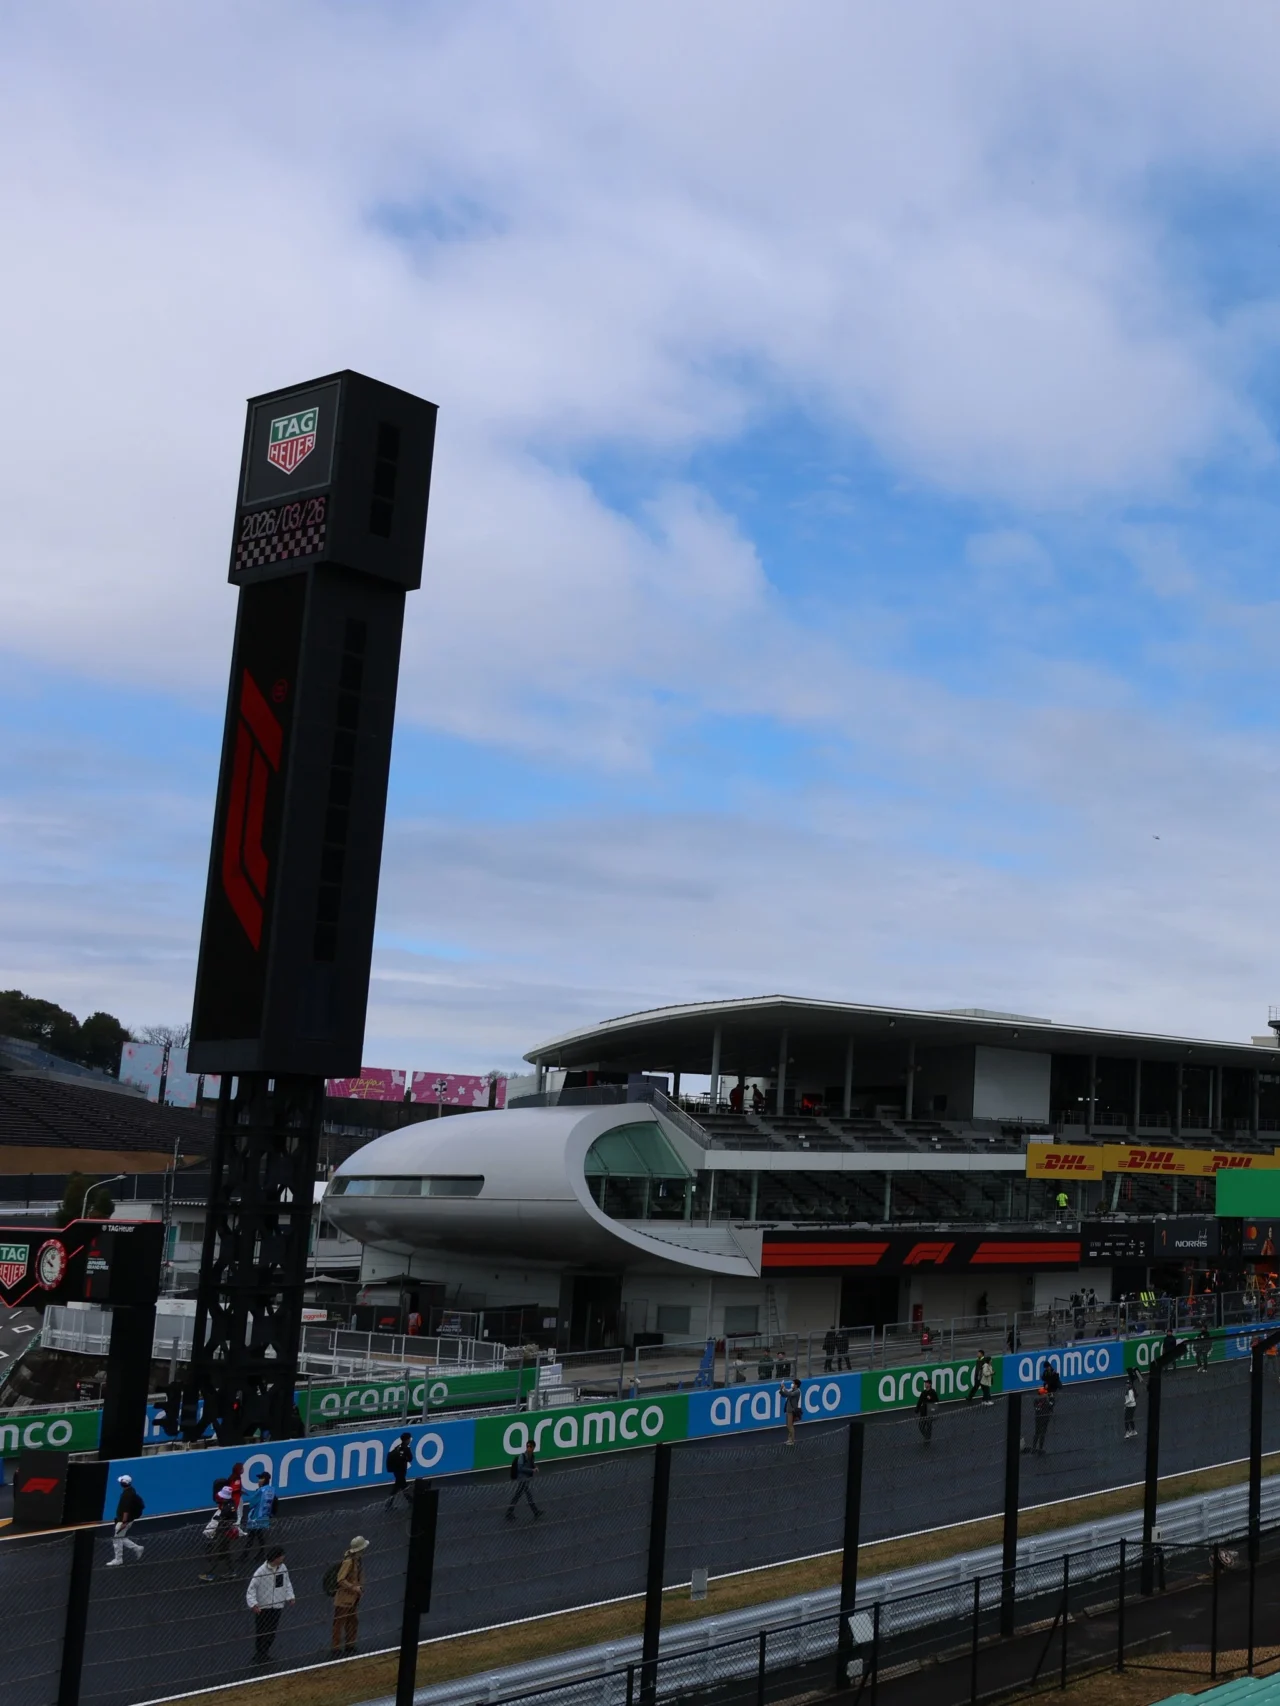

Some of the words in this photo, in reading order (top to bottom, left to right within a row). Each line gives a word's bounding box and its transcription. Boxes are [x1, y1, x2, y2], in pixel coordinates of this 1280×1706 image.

[274, 413, 314, 440] TAG
[270, 436, 315, 469] HEUER
[240, 496, 326, 542] 2026/03/26
[1044, 1154, 1087, 1171] DHL
[1127, 1150, 1177, 1170] DHL
[0, 1247, 26, 1261] TAG
[1175, 1240, 1208, 1248] NORRIS
[303, 1312, 327, 1321] aggreko
[878, 1364, 976, 1403] aramc
[320, 1382, 449, 1418] aramco
[502, 1404, 665, 1455] aramco
[243, 1432, 444, 1492] aramo
